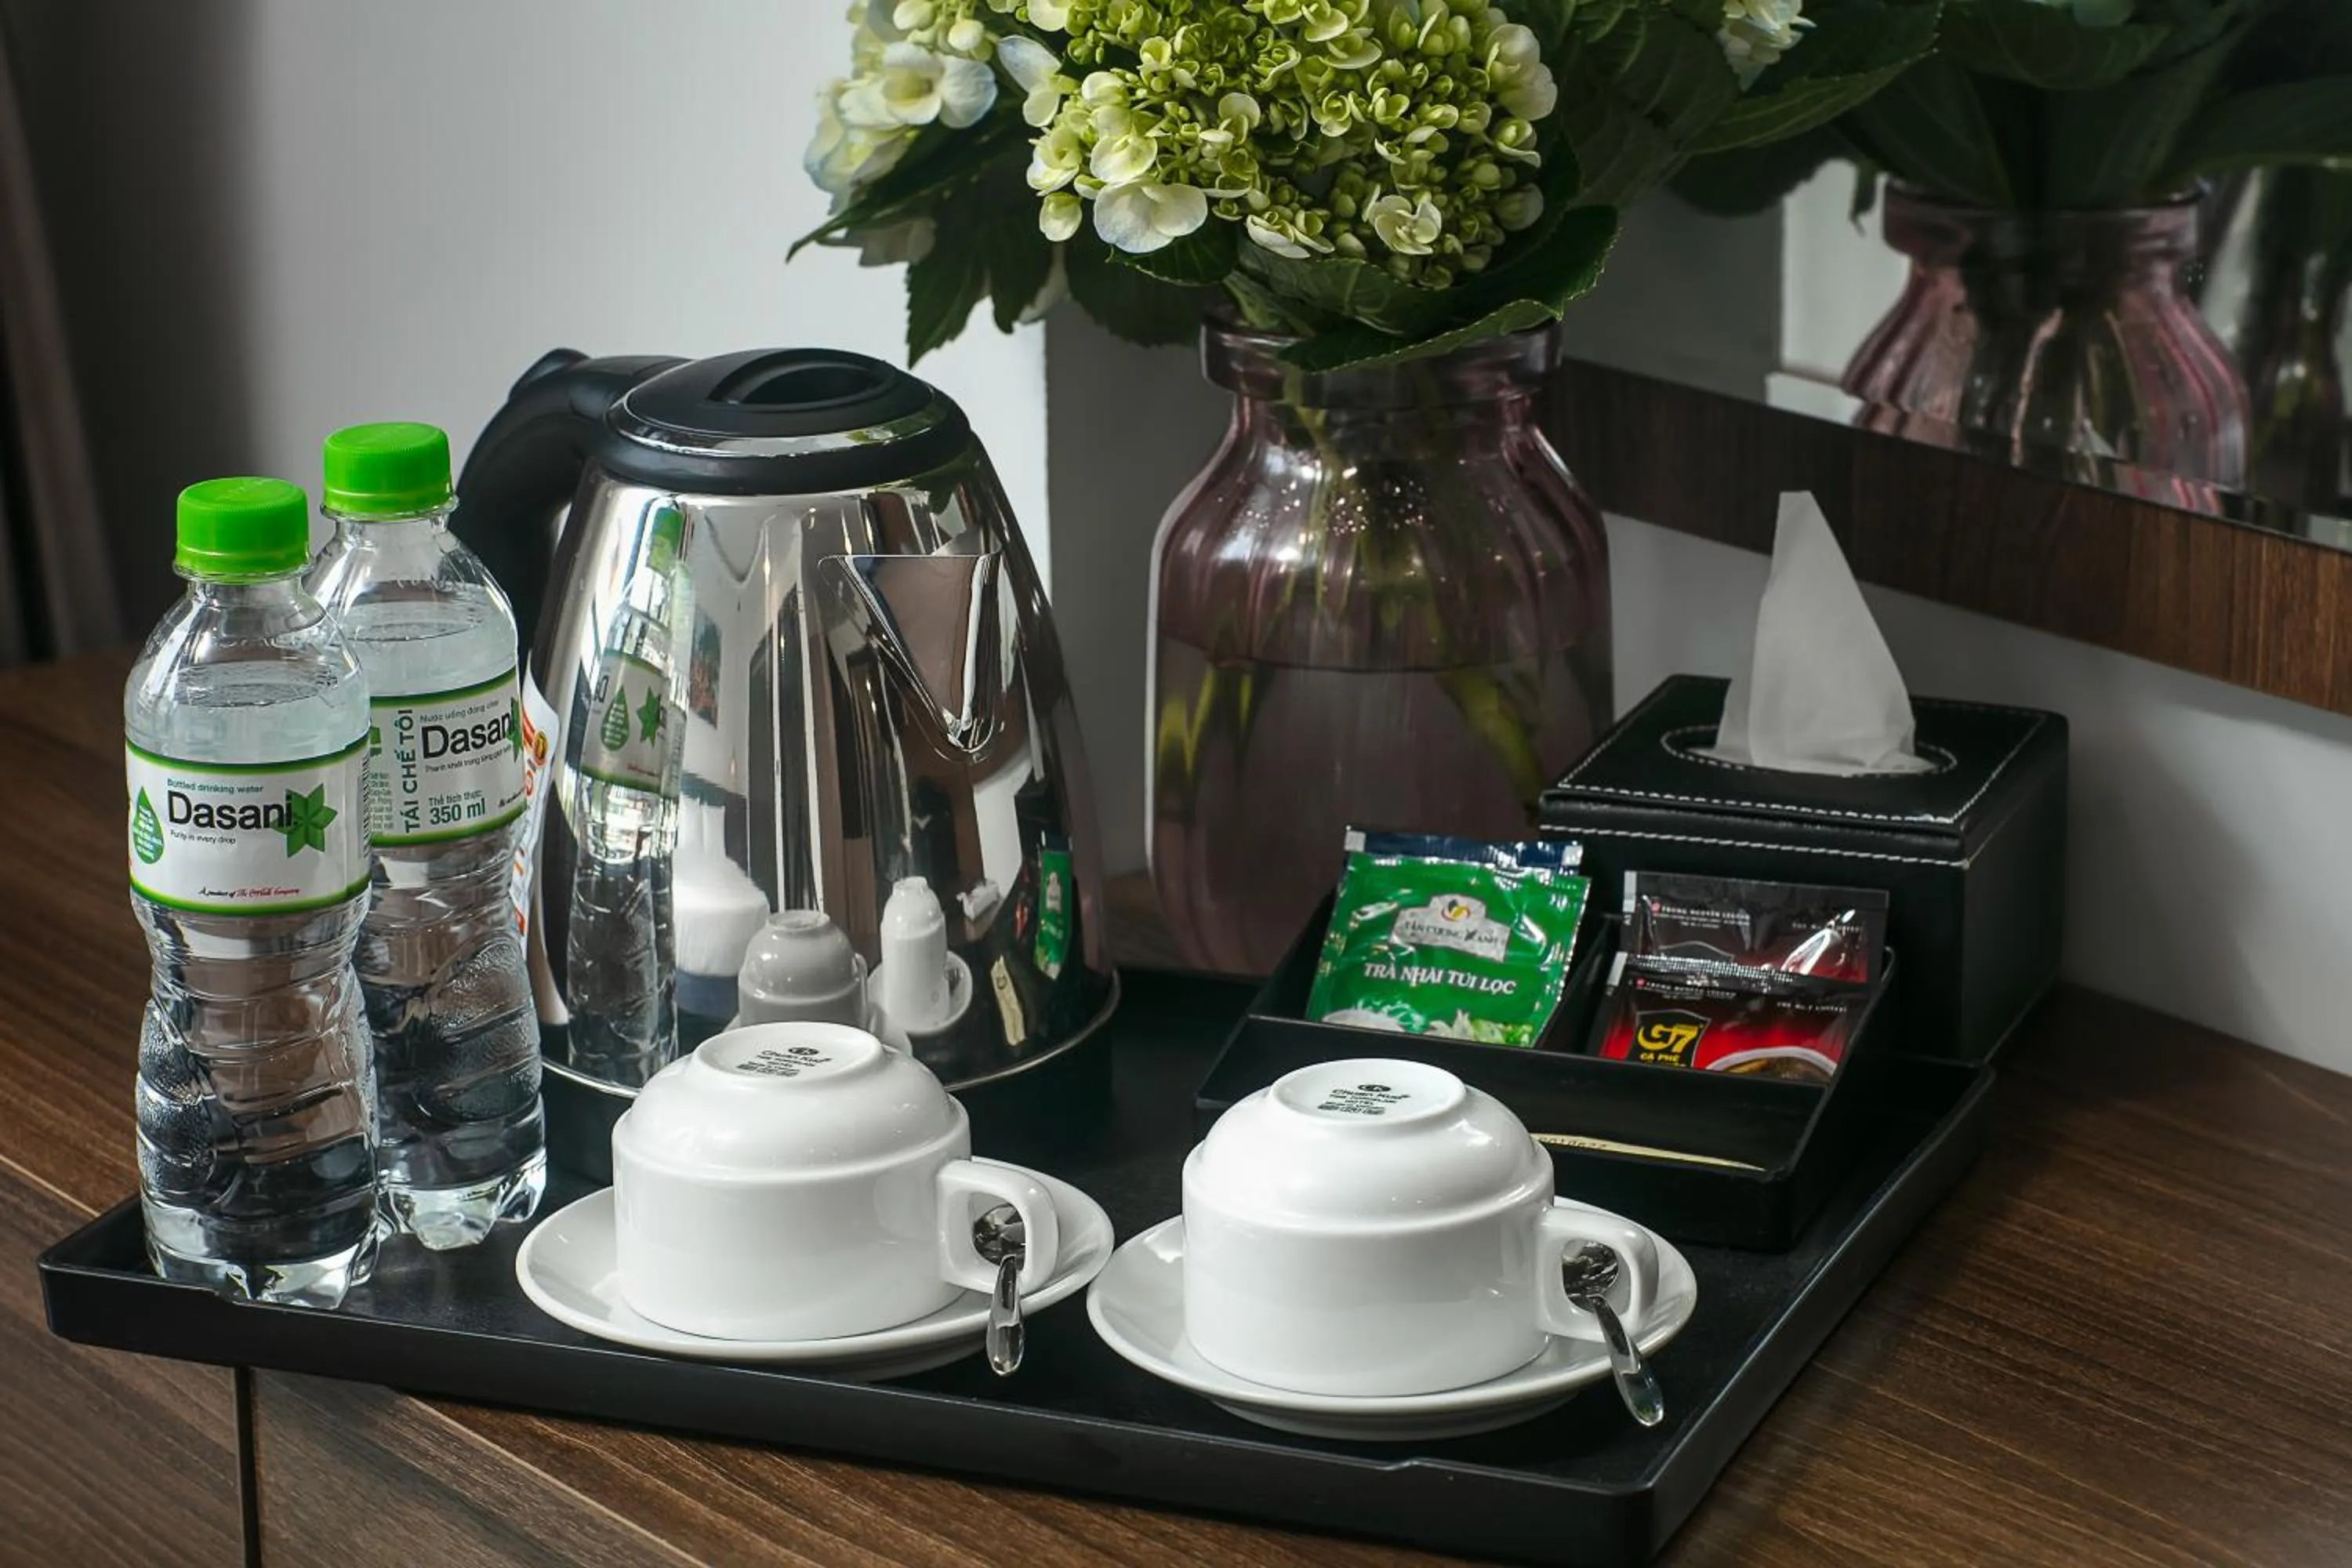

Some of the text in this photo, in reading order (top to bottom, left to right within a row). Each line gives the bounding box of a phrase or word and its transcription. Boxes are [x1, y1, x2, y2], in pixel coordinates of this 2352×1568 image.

[394, 709, 421, 833] TÁI CHẾ TÔI
[197, 784, 234, 794] drinking
[168, 789, 292, 829] Dasani
[430, 804, 462, 825] 350
[466, 797, 486, 818] ml
[1479, 977, 1517, 995] LỌC
[1638, 1023, 1699, 1053] G7
